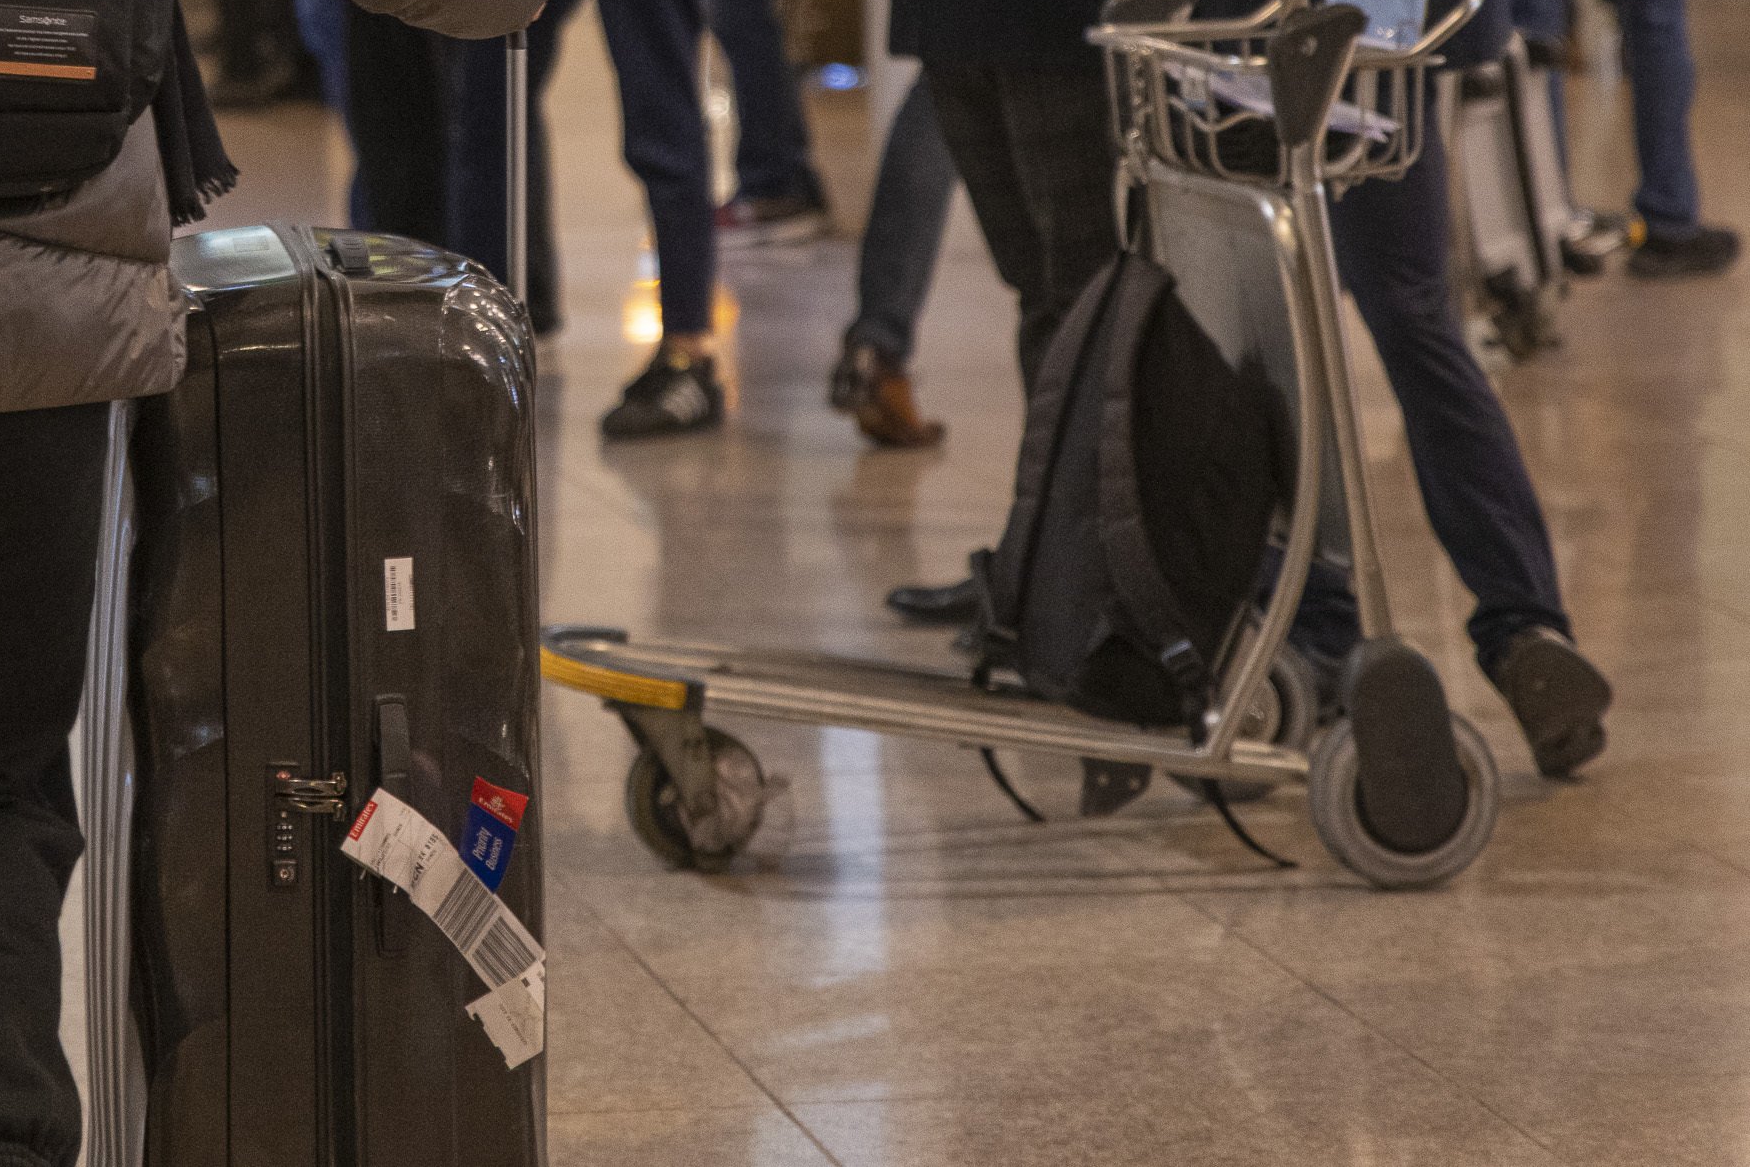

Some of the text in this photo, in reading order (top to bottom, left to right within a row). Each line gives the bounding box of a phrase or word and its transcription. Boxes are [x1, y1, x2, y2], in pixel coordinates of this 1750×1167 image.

[19, 15, 68, 26] Samsonite
[351, 802, 376, 839] Emirates
[472, 827, 492, 861] Priority
[485, 836, 503, 871] Business
